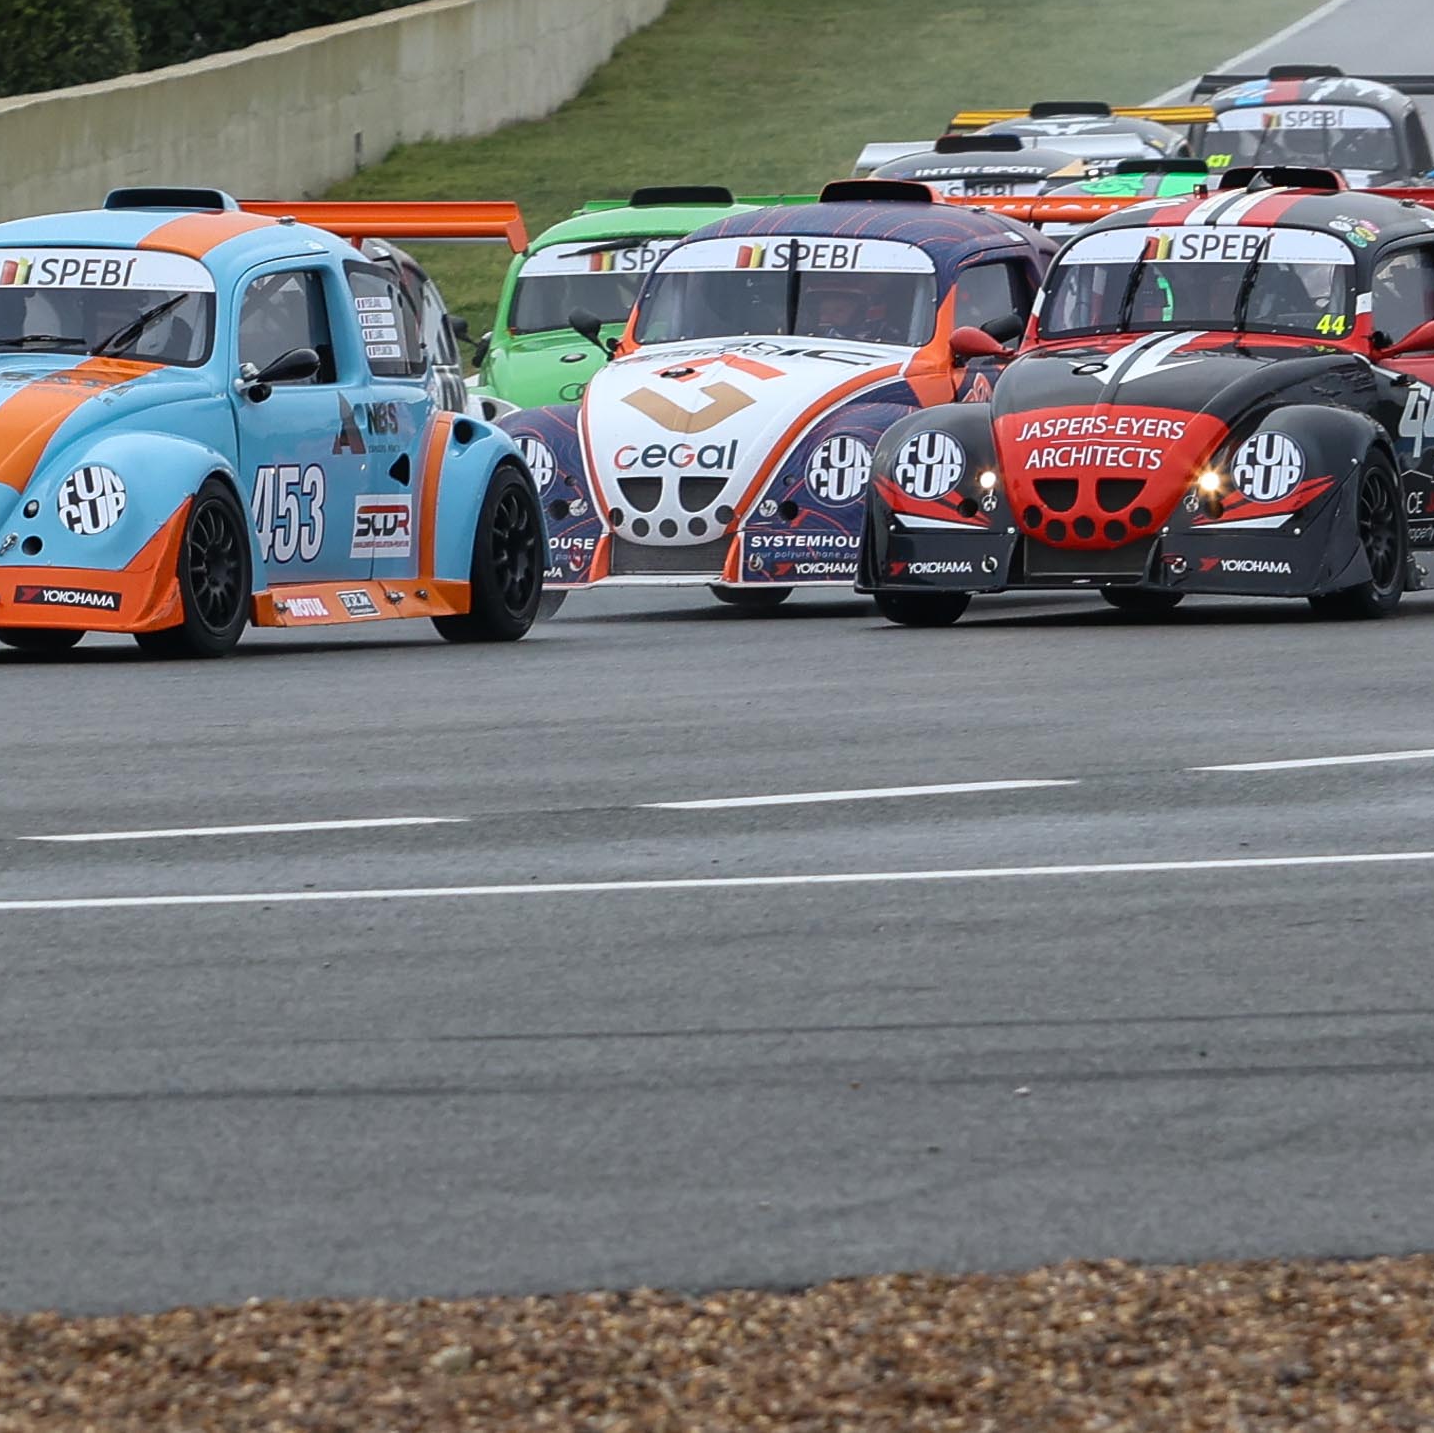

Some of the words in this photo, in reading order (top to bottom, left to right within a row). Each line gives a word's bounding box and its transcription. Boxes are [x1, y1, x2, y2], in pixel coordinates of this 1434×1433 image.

[1315, 314, 1346, 335] 44
[1015, 415, 1186, 443] JASPERS-EYERS
[514, 438, 553, 468] UN
[811, 436, 871, 468] FUN
[898, 433, 963, 464] FUN
[1024, 445, 1164, 471] ARCHITECTS
[1236, 434, 1302, 466] FUN
[57, 466, 126, 502] FUN
[809, 467, 871, 507] CUP
[895, 464, 962, 497] CUP
[1233, 465, 1301, 500] CUP
[58, 493, 126, 535] CUP
[251, 463, 326, 564] 453
[907, 562, 973, 574] YOKOHAMA
[1220, 559, 1292, 575] YOKOHAMA
[42, 588, 116, 609] YOKOHAMA
